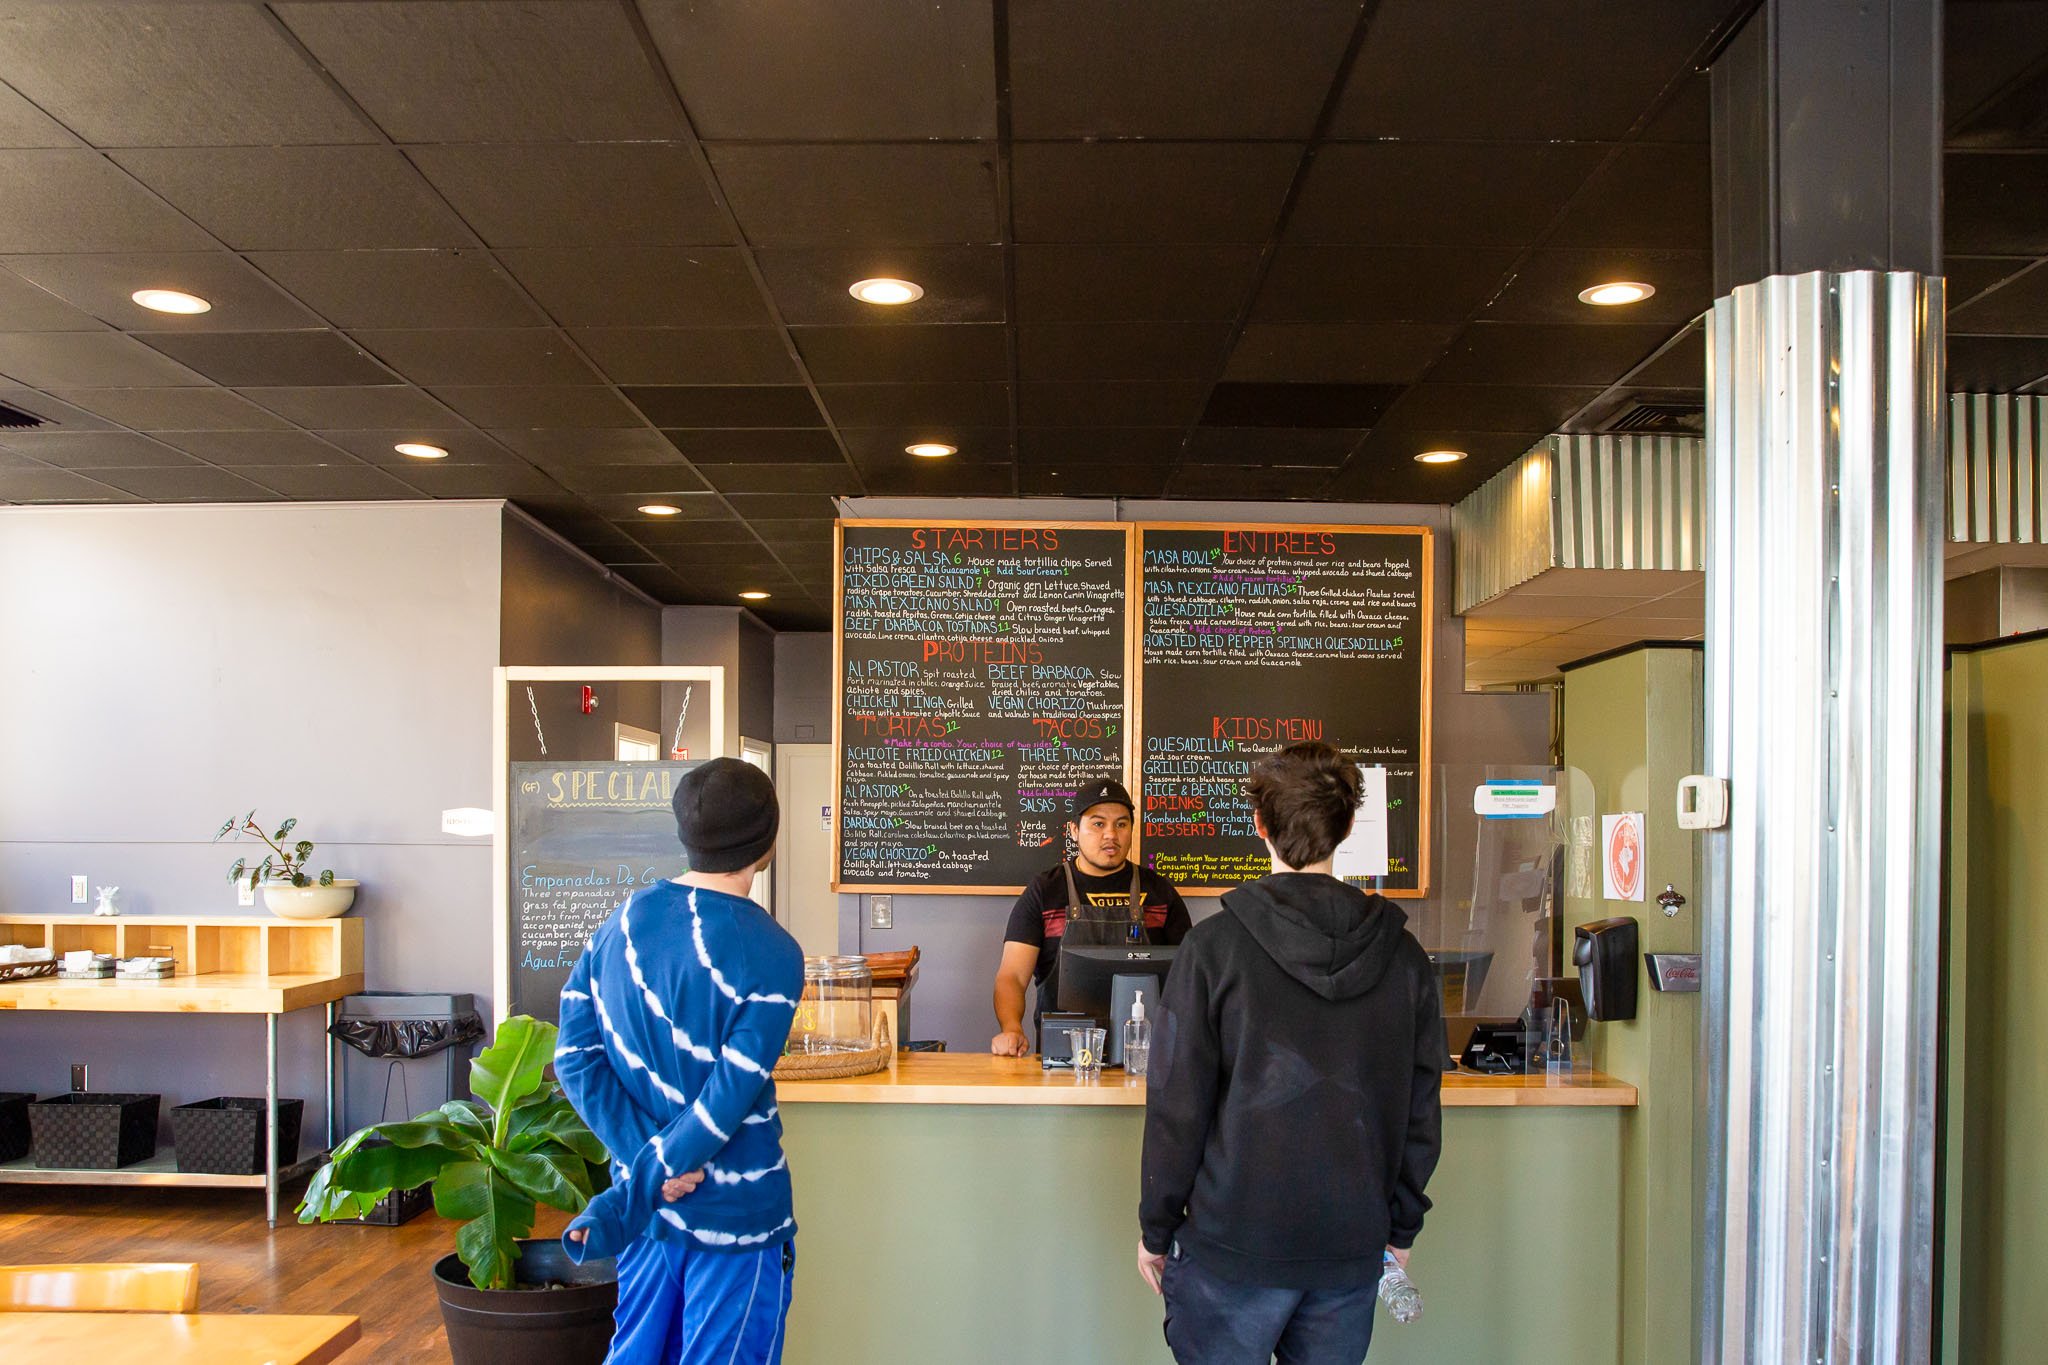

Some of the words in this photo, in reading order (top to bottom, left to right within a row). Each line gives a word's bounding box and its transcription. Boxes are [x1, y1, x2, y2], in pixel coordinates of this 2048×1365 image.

[912, 529, 1059, 550] STARTERS
[1223, 530, 1336, 555] ENTREE'S
[844, 547, 891, 564] CHIPS
[904, 551, 951, 565] SALSA
[954, 553, 964, 564] 6
[998, 557, 1020, 566] made
[1060, 557, 1082, 569] chips
[1144, 550, 1180, 565] MASA
[1182, 550, 1213, 565] BOWL
[1210, 548, 1221, 560] 14
[1266, 556, 1292, 568] protein
[1331, 559, 1345, 567] rice
[1348, 559, 1362, 568] and
[1383, 557, 1410, 570] topped
[866, 564, 888, 573] Salsa
[890, 564, 916, 573] Fresca
[924, 565, 939, 575] Add
[941, 565, 981, 574] Guacamole
[982, 568, 991, 577] 4
[996, 566, 1014, 576] Add
[1017, 567, 1036, 576] Sour
[1037, 567, 1063, 576] Cream
[1292, 567, 1321, 577] whipped
[844, 574, 889, 588] MIXED
[892, 574, 935, 589] GREEN
[938, 575, 974, 589] SALAD
[976, 577, 985, 589] 7
[988, 579, 1021, 592] Organic
[1144, 581, 1175, 594] MASA
[1178, 582, 1239, 595] MEXICANO
[1241, 583, 1287, 597] FLAUTAS
[1297, 585, 1320, 597] Three
[998, 591, 1020, 599] carrot
[1023, 591, 1037, 599] and
[845, 596, 877, 609] MASA
[880, 597, 950, 610] MEXICANO
[952, 598, 993, 611] SALAD
[994, 599, 1000, 611] 9
[1007, 600, 1027, 612] Oven
[1028, 602, 1060, 612] roasted
[1144, 603, 1226, 617] QUESADILLA
[1234, 607, 1256, 618] House
[1339, 609, 1356, 619] with
[999, 612, 1016, 620] and
[1018, 612, 1042, 621] Citrus
[1193, 617, 1207, 626] and
[845, 618, 879, 630] BEEF
[884, 619, 944, 632] BARBACOA
[946, 620, 997, 633] TOSTADAS
[1012, 624, 1032, 634] Slow
[996, 635, 1010, 643] and
[1010, 635, 1035, 644] pickled
[1144, 633, 1197, 648] ROASTED
[1199, 634, 1225, 648] RED
[1228, 634, 1275, 649] PEPPER
[1276, 635, 1323, 650] SPINACH
[1324, 636, 1394, 651] QUESADILLA
[1393, 636, 1405, 647] 15
[923, 640, 1042, 664] PROTEINS
[1144, 647, 1163, 656] House
[1244, 657, 1259, 666] and
[849, 660, 864, 677] AL
[867, 660, 920, 678] PASTOR
[923, 668, 940, 680] Spit
[943, 668, 976, 679] roasted
[988, 664, 1028, 679] BEEF
[1032, 665, 1095, 679] BARBACOA
[1100, 669, 1121, 679] Slow
[883, 687, 900, 695] and
[1044, 689, 1062, 697] and
[903, 695, 947, 709] TINGA
[947, 697, 975, 709] Grilled
[988, 696, 1024, 710] VEGAN
[1027, 697, 1085, 711] CHORIZO
[848, 709, 875, 717] Chicken
[855, 714, 946, 737] TORTAS
[945, 720, 960, 733] 12
[1032, 718, 1101, 738] TACOS
[1105, 725, 1117, 738] 12
[1213, 717, 1273, 740] KIDS
[1275, 718, 1323, 741] MENU
[1051, 736, 1061, 748] 3
[1147, 737, 1230, 753] QUESADILLA
[1237, 743, 1251, 752] Two
[847, 747, 901, 760] ACHIOTE
[906, 748, 942, 761] FRIED
[991, 750, 1005, 760] 12
[1018, 748, 1060, 761] THREE
[1063, 747, 1102, 761] TACOS
[1103, 752, 1120, 762] with
[1149, 752, 1164, 760] and
[1020, 764, 1036, 773] your
[1038, 763, 1060, 771] choice
[1143, 760, 1199, 775] GRILLED
[521, 780, 541, 795] (GF)
[844, 784, 857, 798] AL
[859, 784, 899, 798] PASTOR
[899, 783, 910, 793] 12
[1144, 783, 1177, 796] RICE
[1181, 784, 1188, 796] &
[1191, 783, 1232, 797] BEANS
[1231, 784, 1238, 796] 8
[1019, 797, 1057, 812] SALSAS
[1146, 796, 1204, 811] DRINKS
[1208, 797, 1230, 810] Coke
[843, 816, 894, 829] BARBACOA
[904, 820, 922, 829] Slow
[1143, 811, 1193, 824] Kombucha
[1206, 811, 1253, 824] Horchata
[1020, 820, 1047, 830] Verde
[1145, 823, 1216, 837] DESSERTS
[1220, 823, 1244, 837] Flan
[1020, 830, 1048, 839] Fresca
[1019, 838, 1041, 848] Arbol
[844, 848, 878, 860] VEGAN
[879, 848, 928, 860] CHORIZO
[938, 851, 950, 860] On
[951, 850, 990, 861] toasted
[1155, 852, 1178, 862] Please
[1246, 854, 1253, 862] if
[843, 868, 875, 877] avocado
[878, 868, 894, 877] and
[915, 860, 941, 869] shaved
[942, 860, 973, 872] cabbage
[1156, 861, 1200, 872] Consuming
[521, 865, 611, 890] Empanadas
[617, 864, 636, 885] De
[1168, 873, 1188, 882] eggs
[521, 888, 551, 898] Three
[555, 888, 616, 899] empanadas
[522, 902, 549, 914] grass
[553, 900, 568, 910] fed
[571, 899, 608, 913] ground
[1097, 898, 1131, 907] GUES
[521, 911, 557, 921] carrots
[522, 921, 585, 932] accompanied
[521, 940, 558, 951] oregano
[560, 939, 580, 950] pico
[521, 950, 556, 970] Agua
